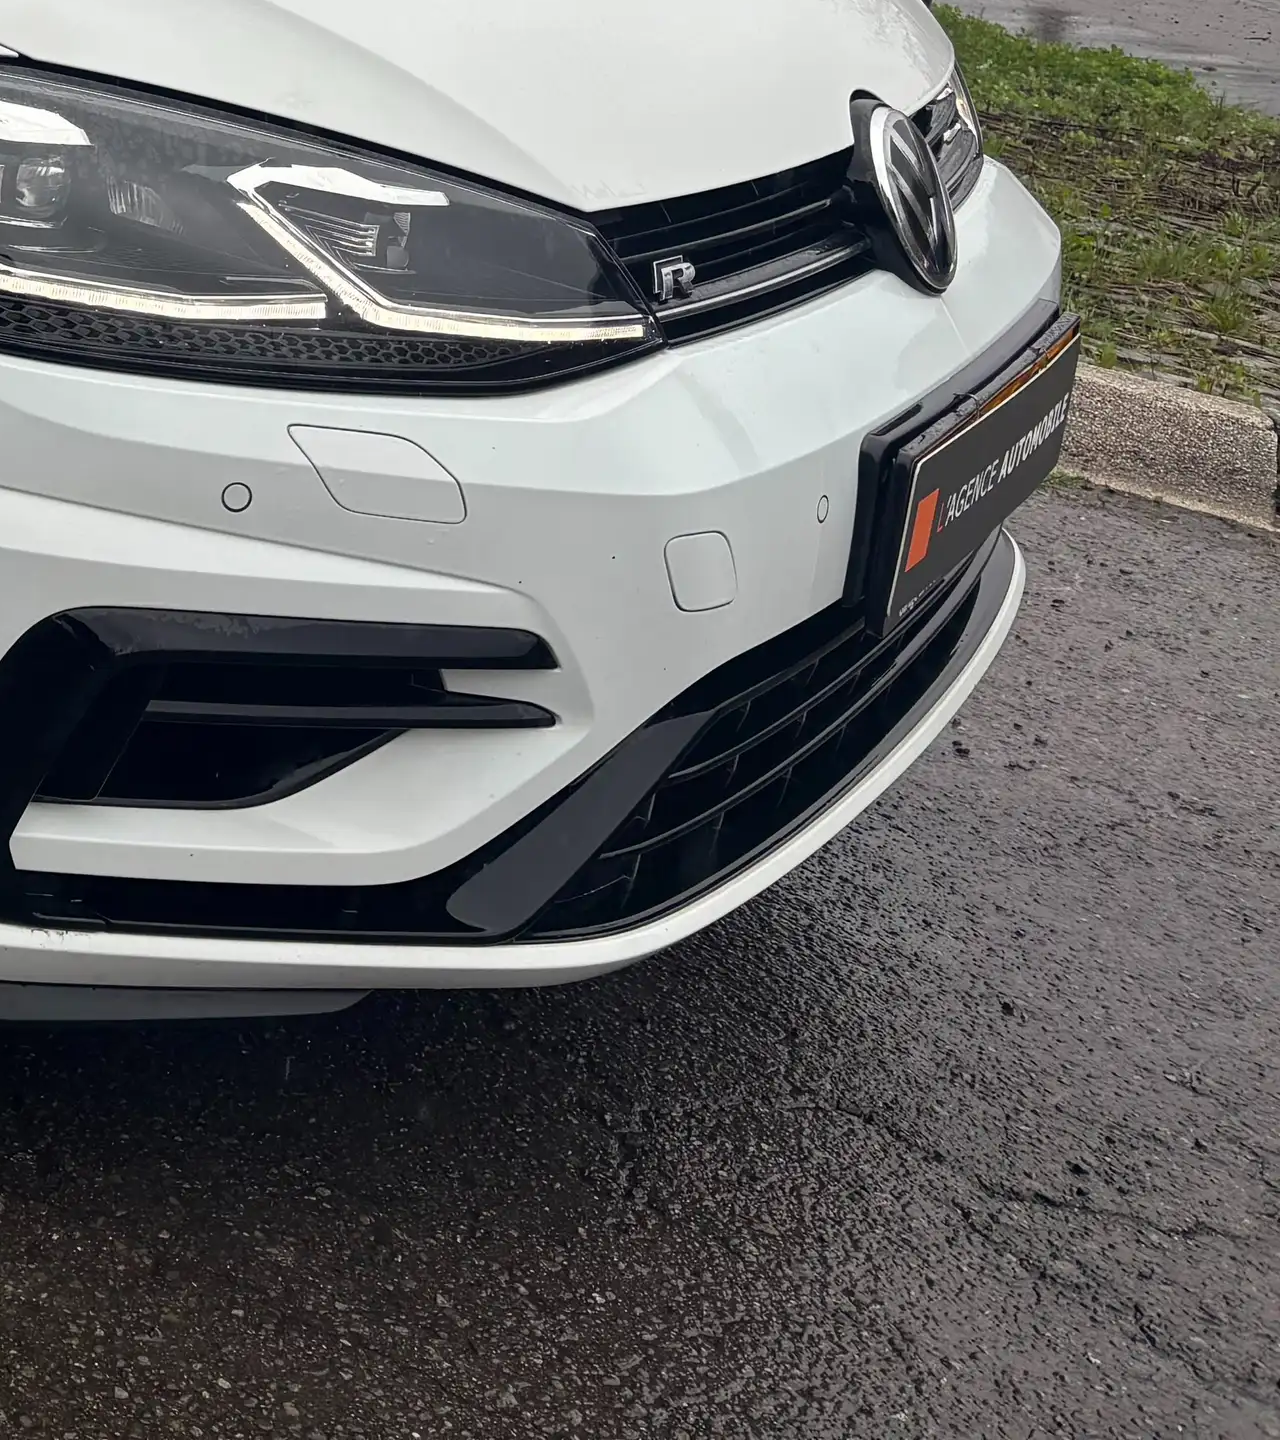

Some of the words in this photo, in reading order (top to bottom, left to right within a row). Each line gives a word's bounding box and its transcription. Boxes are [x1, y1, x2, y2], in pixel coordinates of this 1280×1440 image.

[657, 259, 695, 300] R
[936, 458, 1000, 533] L'AGENCE
[997, 391, 1070, 484] AUTOMOBILE
